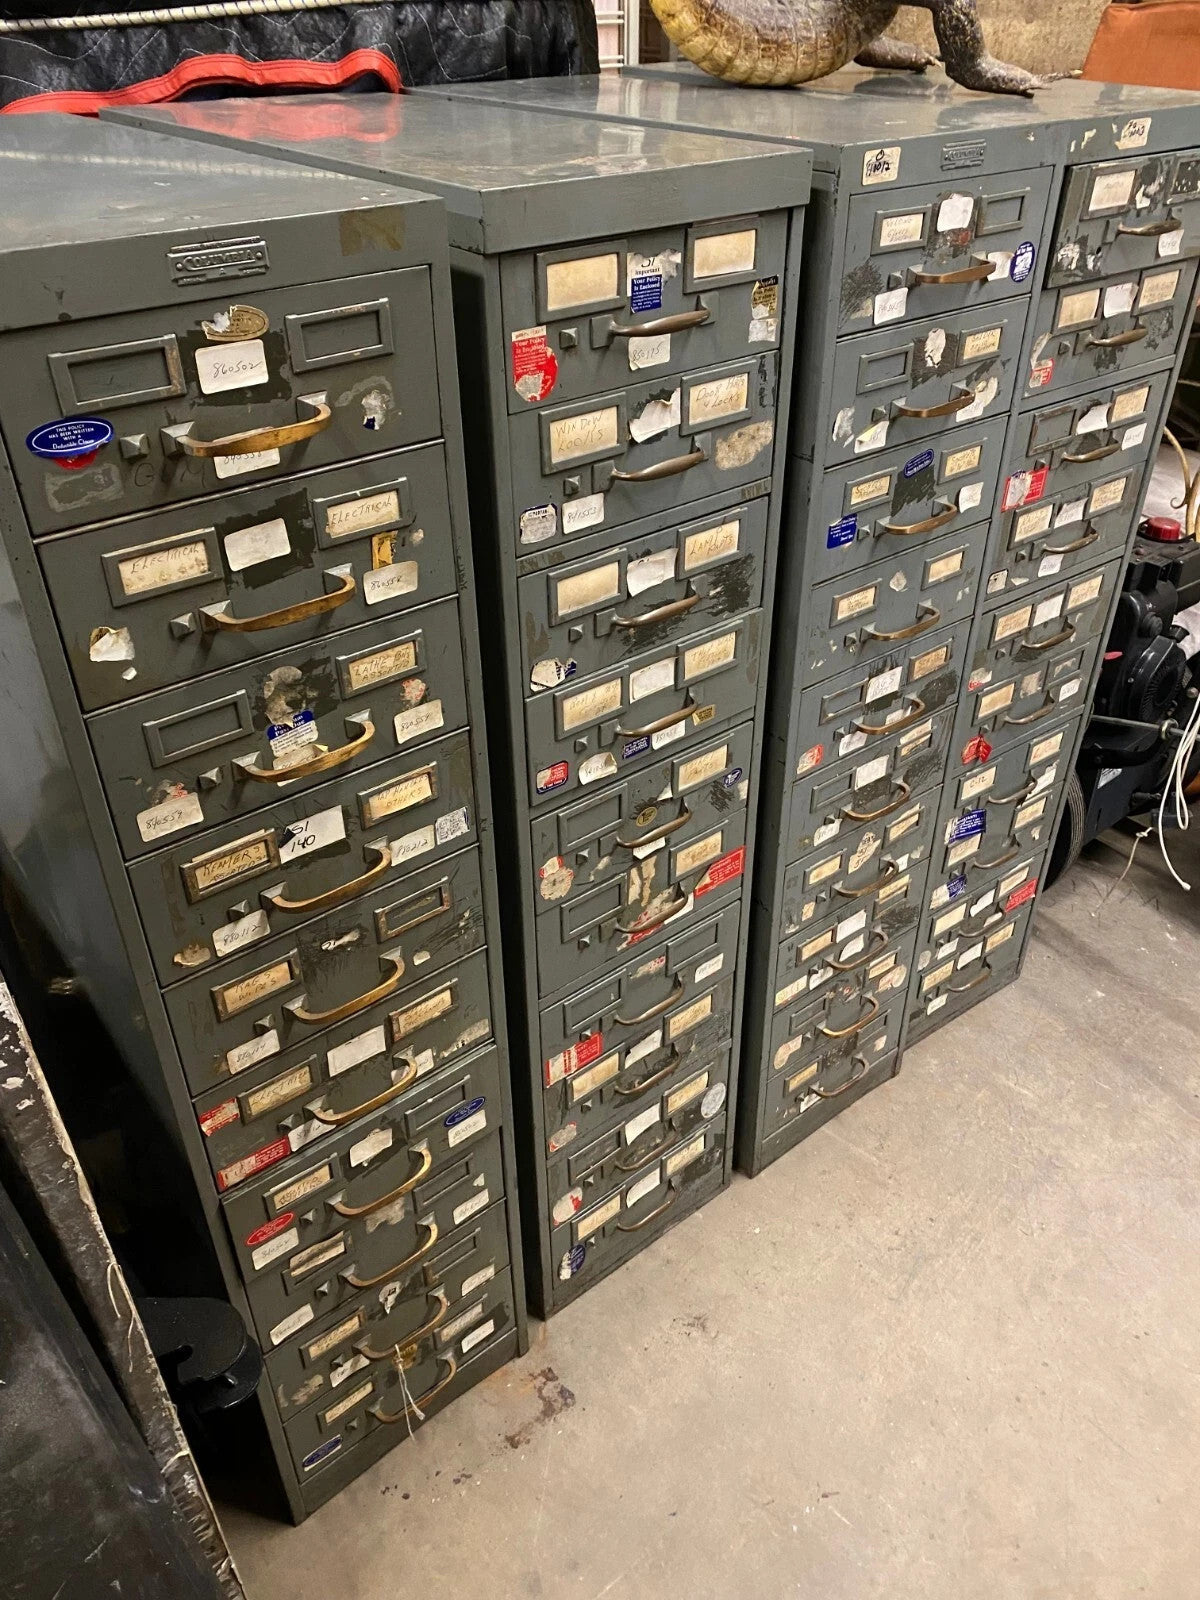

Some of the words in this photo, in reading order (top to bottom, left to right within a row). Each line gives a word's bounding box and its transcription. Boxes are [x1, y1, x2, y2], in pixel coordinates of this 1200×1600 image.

[640, 282, 661, 290] Enclosed
[213, 360, 262, 379] 860502
[52, 442, 77, 450] Deductible
[331, 495, 392, 525] ELECTRICAL
[131, 541, 199, 574] ELECTRICAL
[291, 834, 316, 853] 140
